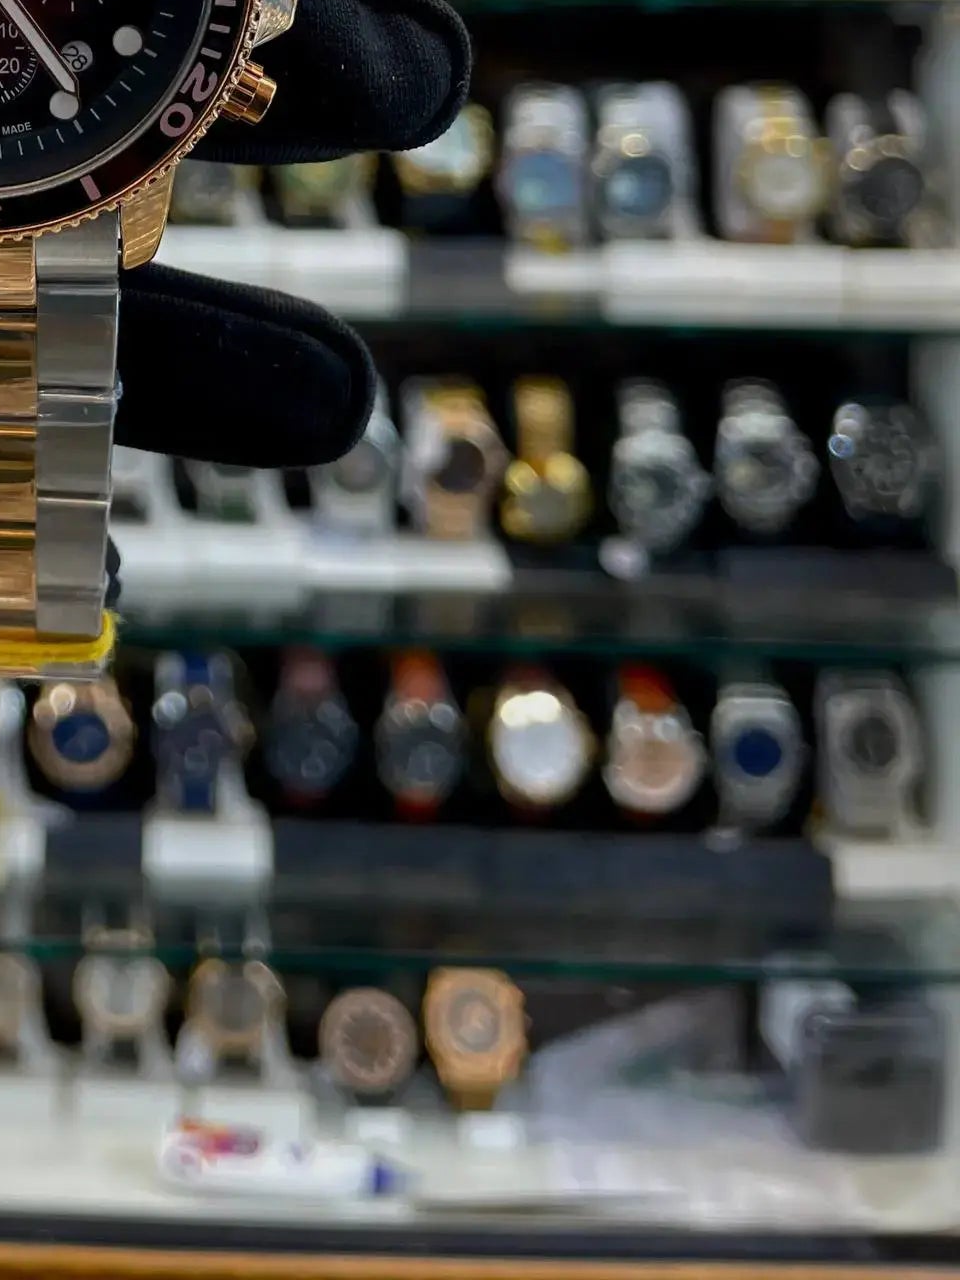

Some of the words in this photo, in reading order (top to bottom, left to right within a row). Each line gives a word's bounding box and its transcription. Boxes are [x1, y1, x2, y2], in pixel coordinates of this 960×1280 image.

[0, 57, 20, 74] 20
[63, 45, 88, 71] 28
[160, 62, 217, 138] 20
[1, 121, 32, 136] MADE
